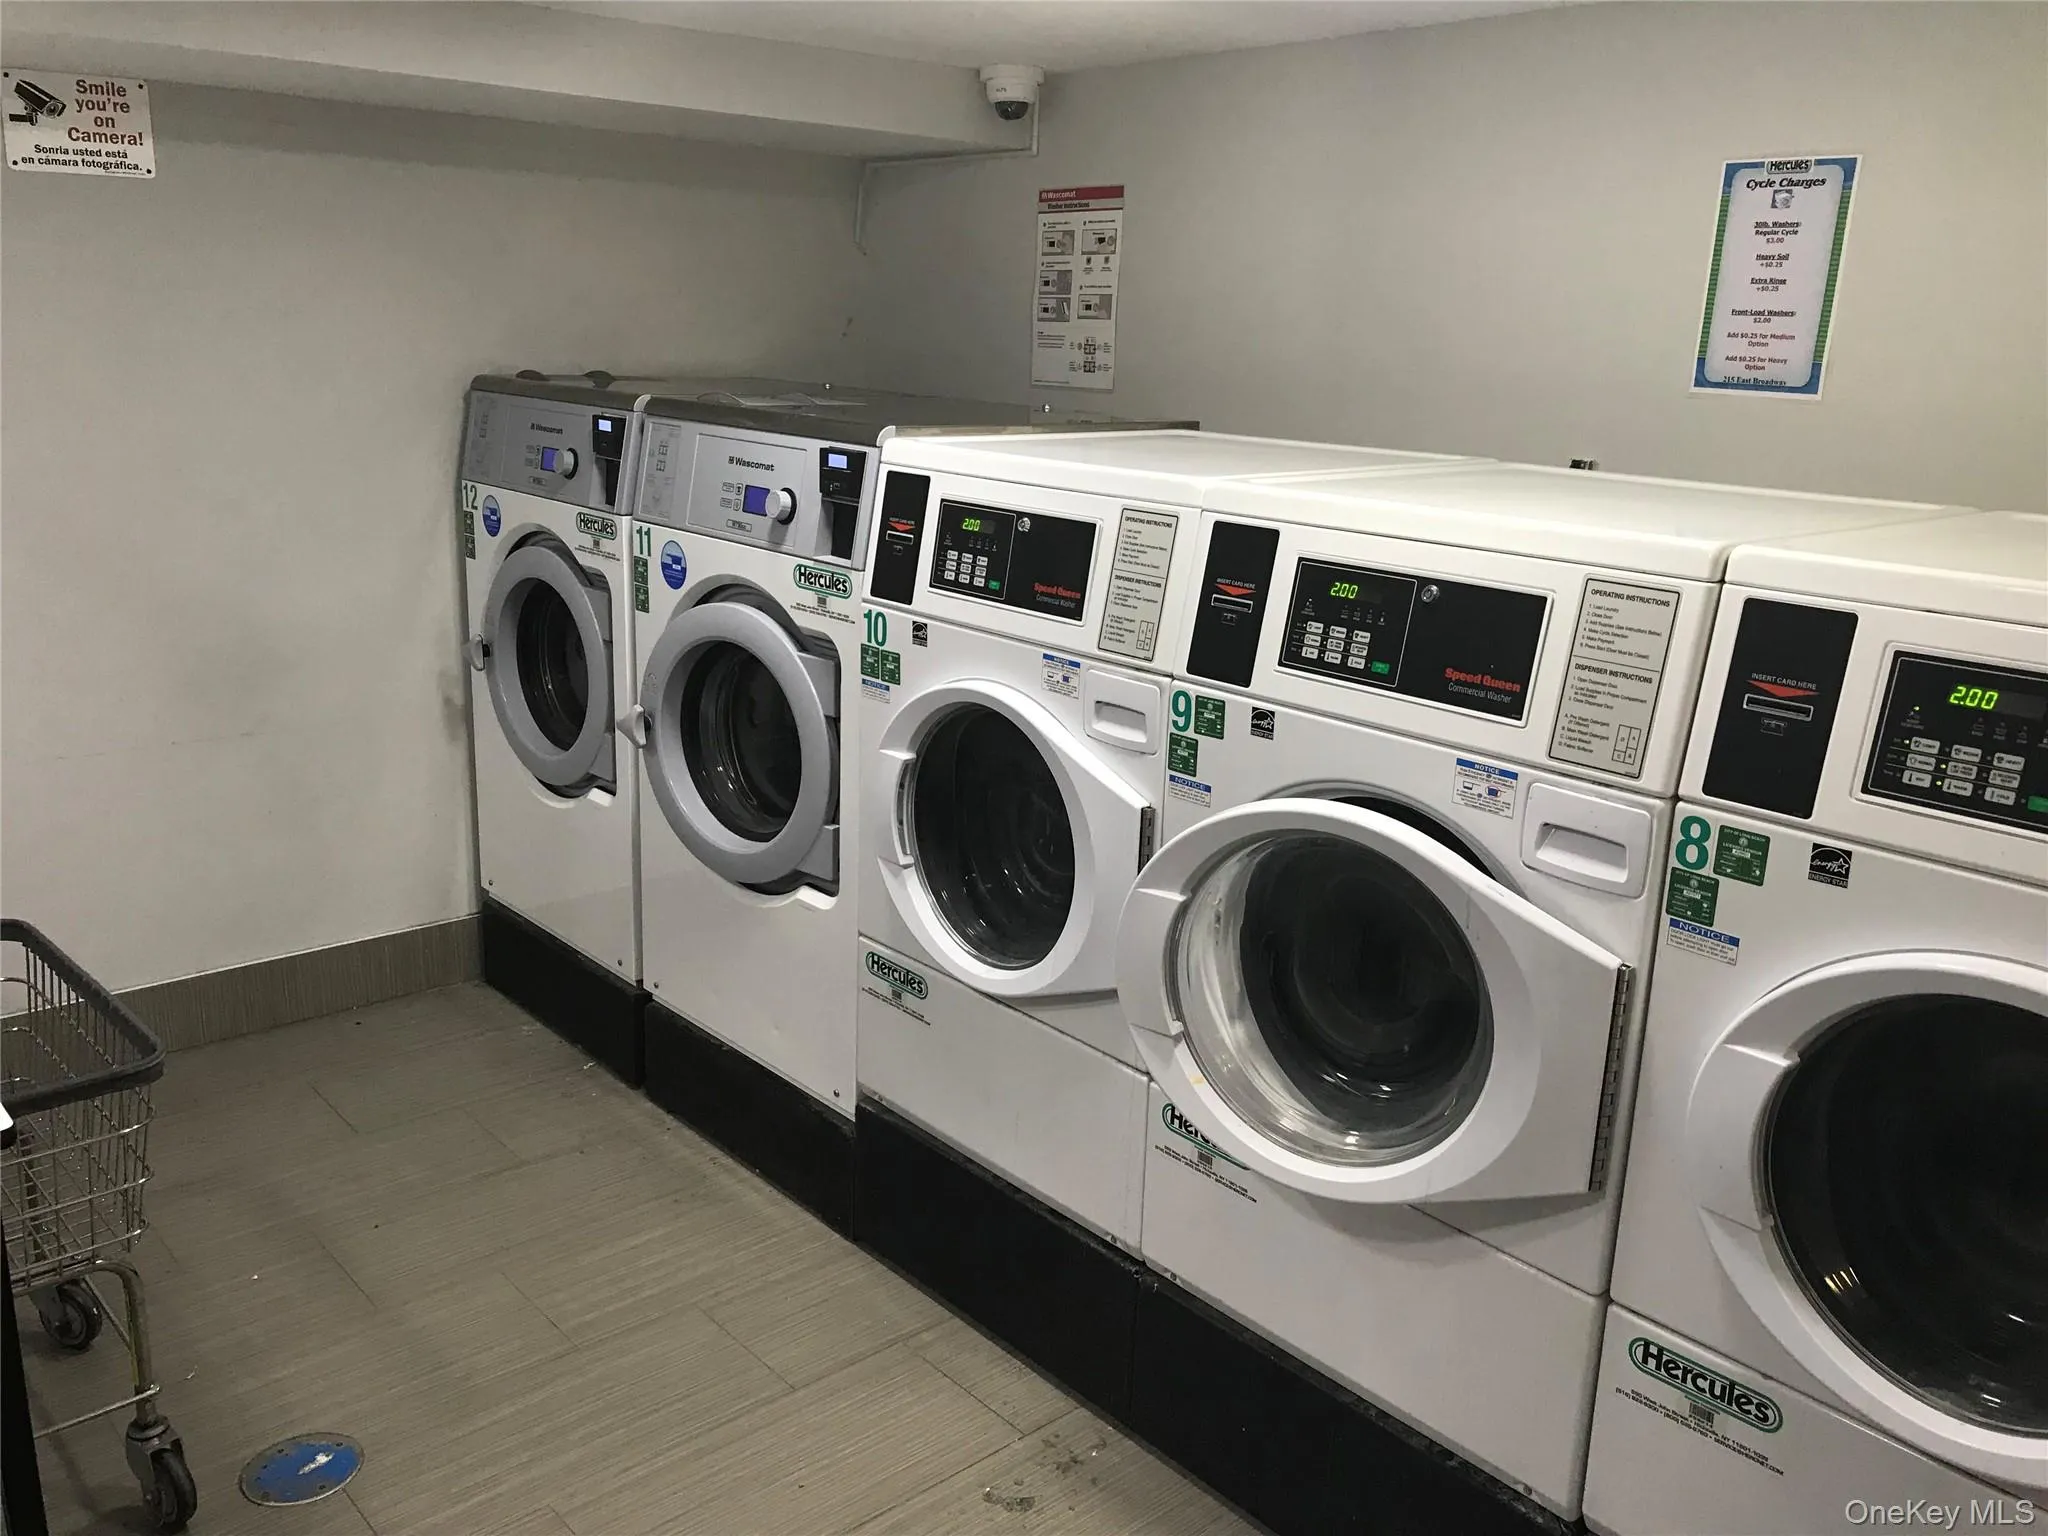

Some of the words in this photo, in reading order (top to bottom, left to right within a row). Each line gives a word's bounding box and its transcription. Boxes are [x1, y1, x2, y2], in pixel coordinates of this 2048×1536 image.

[75, 79, 127, 97] Smile
[74, 97, 130, 113] you're
[93, 115, 116, 128] on
[67, 126, 144, 146] Camera!
[21, 156, 35, 165] en
[72, 147, 102, 157] usted
[1769, 160, 1810, 171] Hercules
[1746, 179, 1777, 191] Cycle
[1779, 177, 1827, 189] Charges
[1754, 229, 1780, 237] Regular
[735, 456, 775, 472] Wascomat
[464, 482, 479, 511] 12
[579, 512, 614, 536] Hercules
[636, 525, 652, 557] 11
[797, 565, 848, 594] Hercules
[1329, 582, 1359, 599] 2.00
[1590, 588, 1625, 600] OPERATING
[1625, 591, 1671, 608] INSTRUCTIONS
[864, 608, 888, 647] 10
[1444, 667, 1481, 684] Speed
[1482, 675, 1521, 693] Queen
[1574, 662, 1609, 676] DISPENSER
[1608, 668, 1653, 684] INSTRUCTIONS
[1751, 672, 1777, 682] INSERT
[1776, 677, 1797, 687] CARD
[1797, 681, 1817, 690] HERE
[1448, 682, 1486, 698] Commercial
[1949, 685, 1999, 710] 2.00
[1171, 690, 1192, 732] 9
[1474, 763, 1500, 775] NOTICE
[1174, 777, 1205, 791] NOTICE
[1675, 815, 1711, 871] 8
[1679, 921, 1730, 942] NOTICE
[870, 953, 924, 994] Hercules
[1641, 1340, 1771, 1424] Hercules
